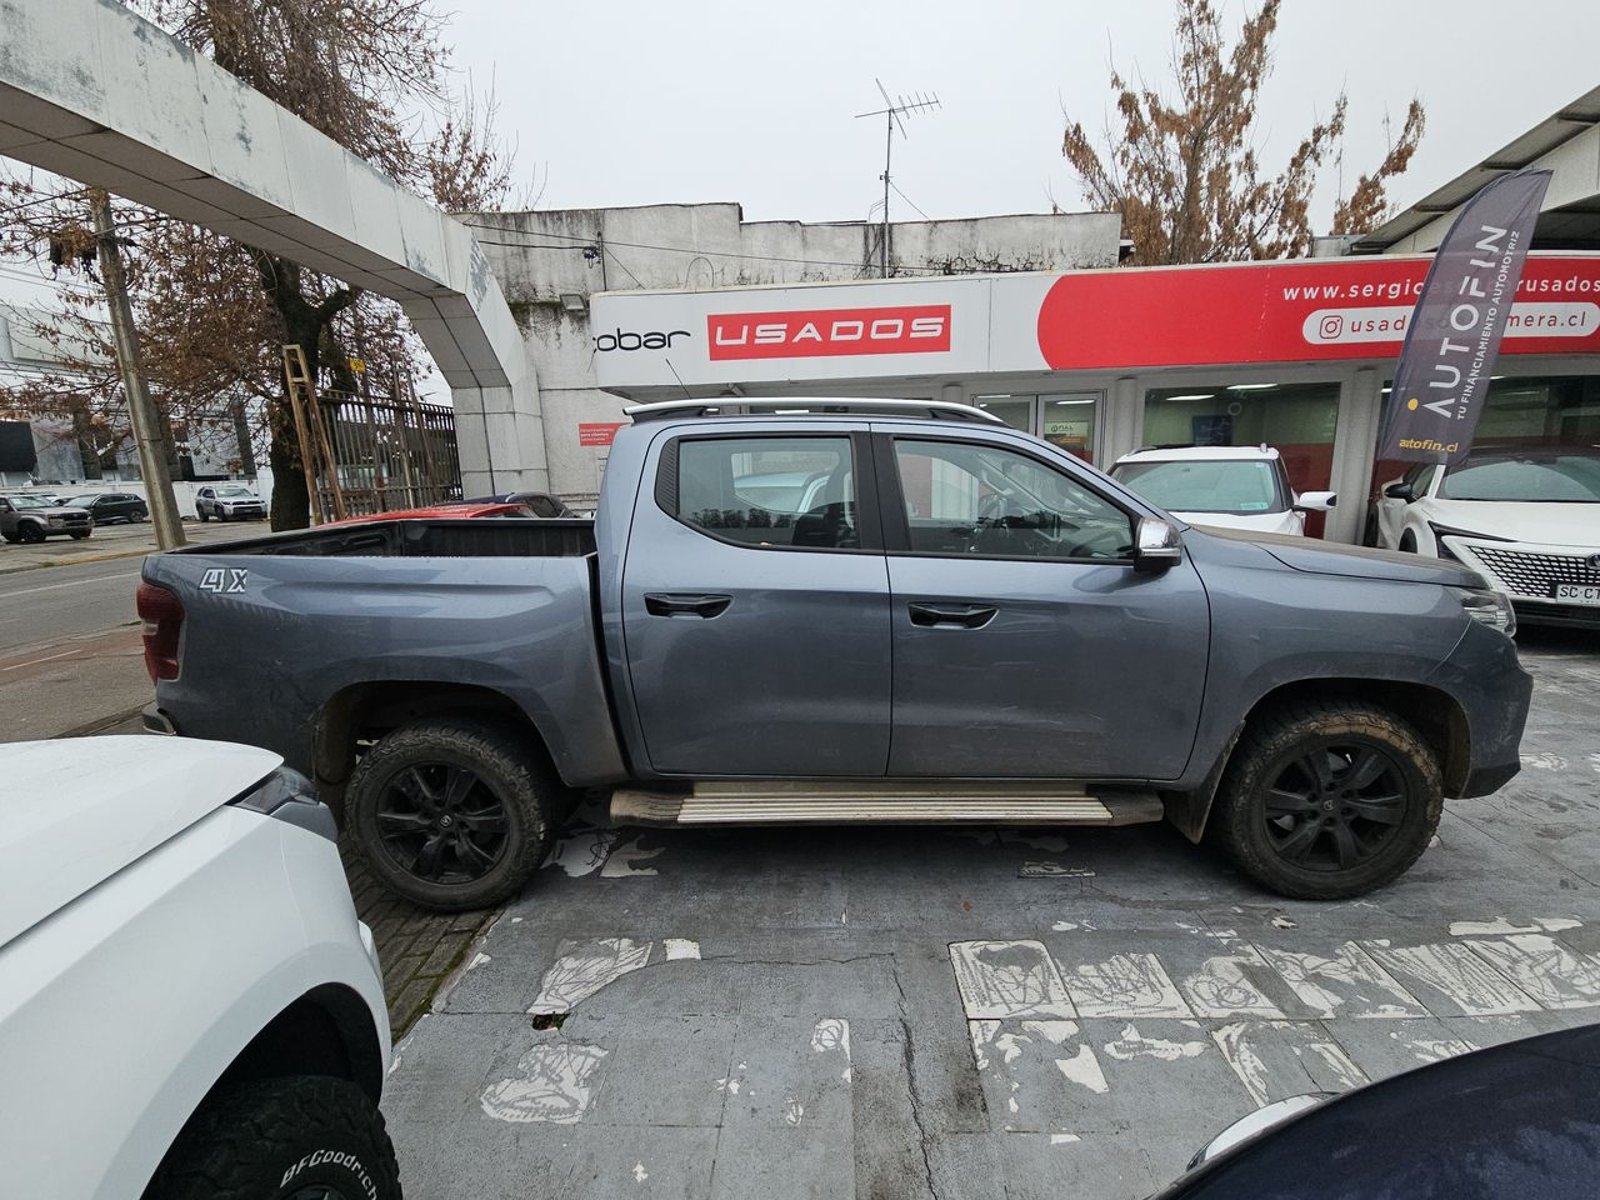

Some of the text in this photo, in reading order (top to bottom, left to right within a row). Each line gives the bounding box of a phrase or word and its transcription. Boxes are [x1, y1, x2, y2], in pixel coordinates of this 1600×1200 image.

[592, 327, 691, 353] obar
[715, 316, 945, 346] USADOS
[1422, 225, 1507, 418] AUTOFIN
[1457, 230, 1520, 420] TU FINANCIAMIENTO AUTOMOTRIZ
